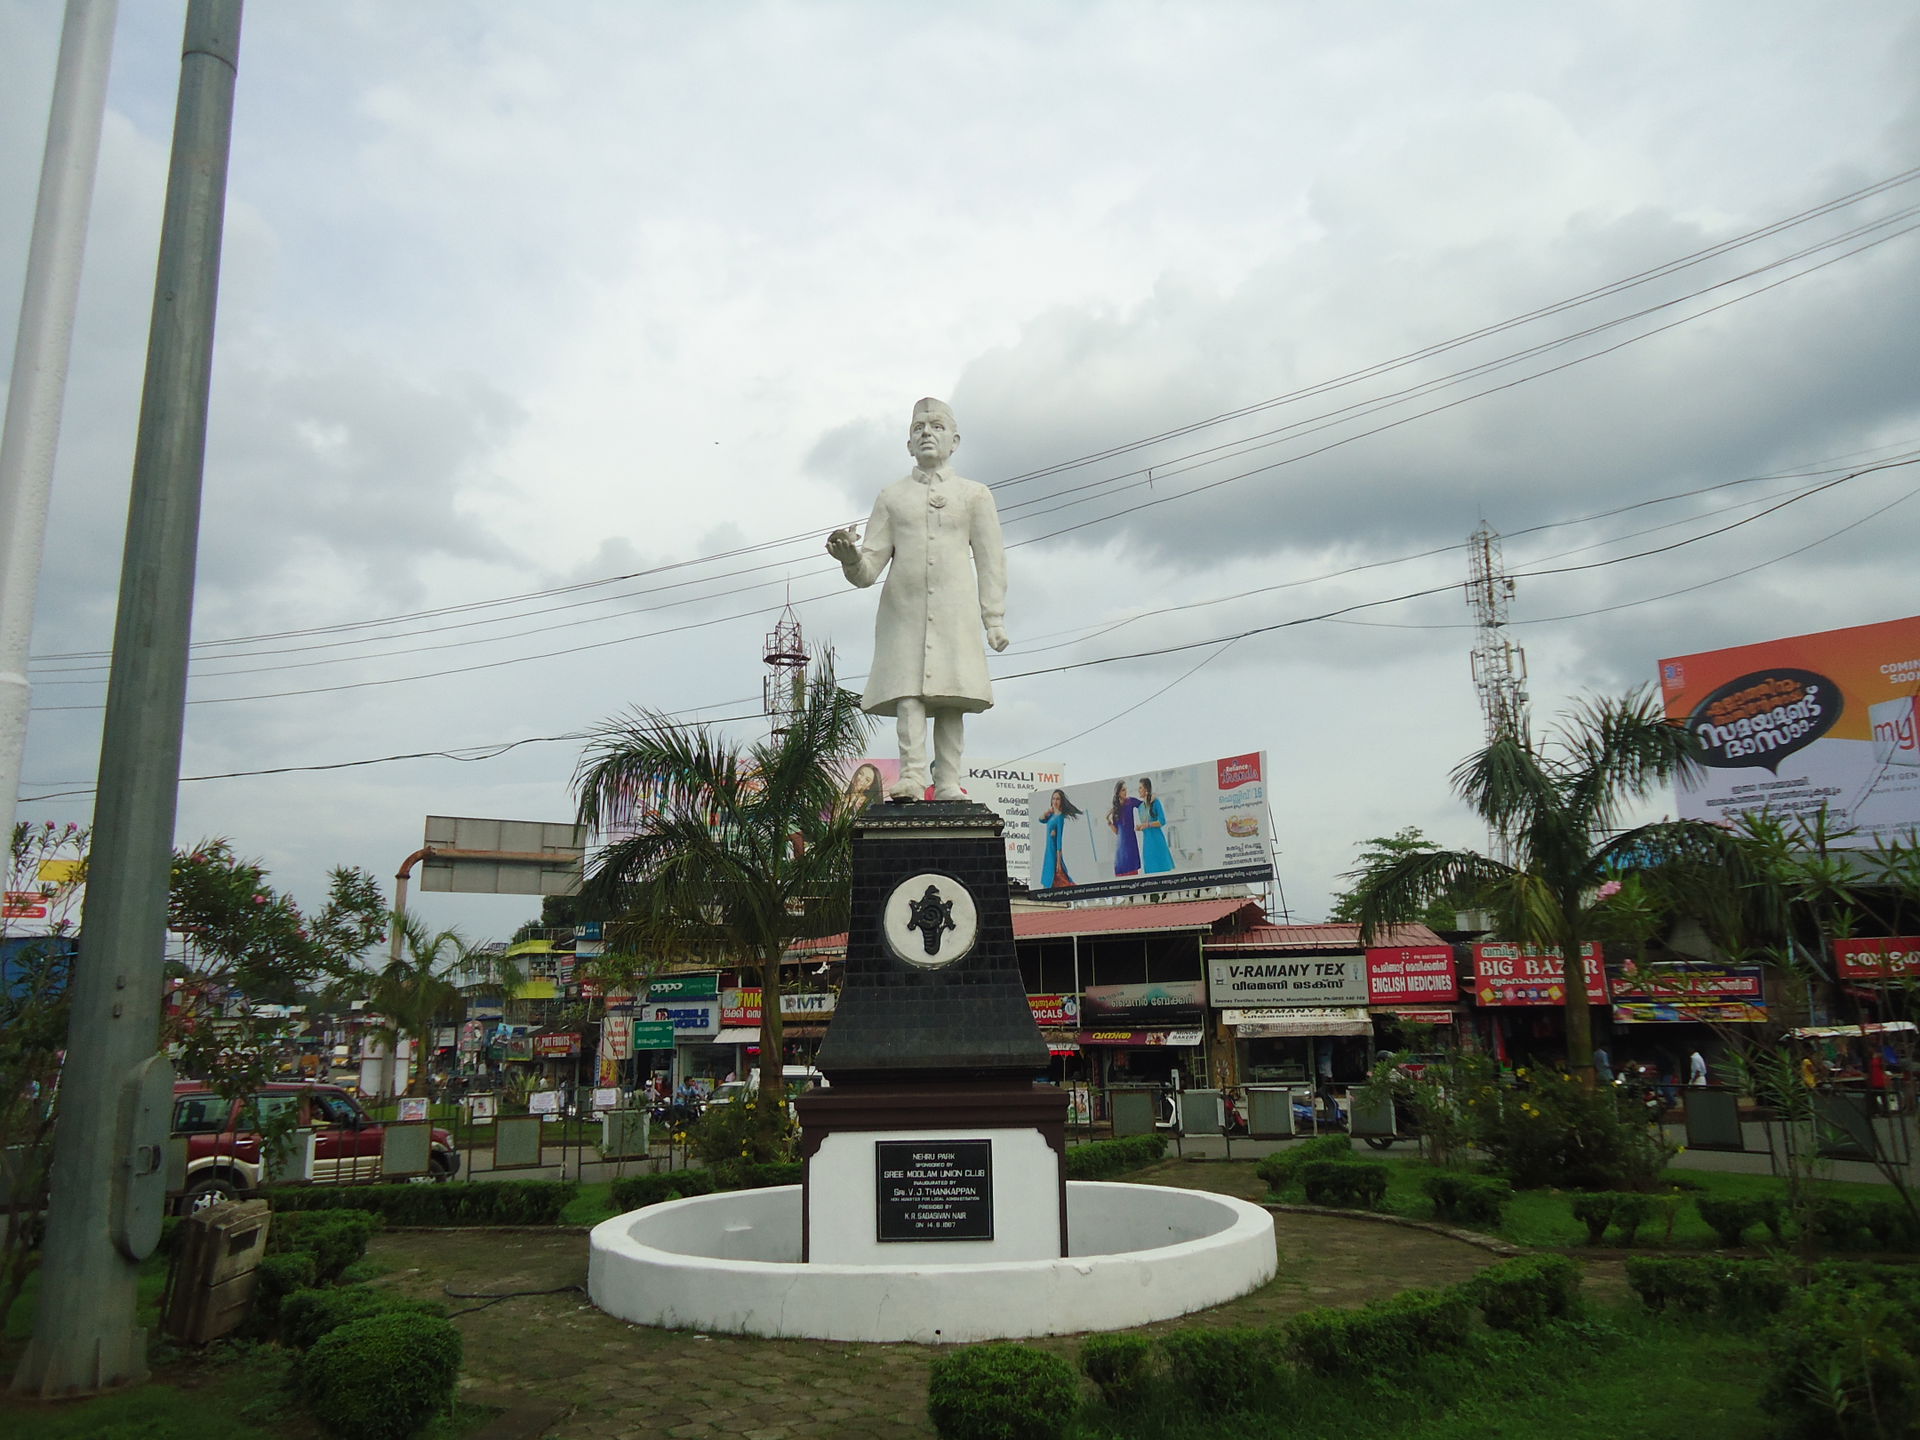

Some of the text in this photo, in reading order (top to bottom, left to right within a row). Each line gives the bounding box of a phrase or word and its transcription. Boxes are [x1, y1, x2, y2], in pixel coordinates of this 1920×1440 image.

[1880, 659, 1920, 675] COMIN
[1873, 716, 1915, 750] my
[968, 768, 1060, 783] KAIRALI TMT
[996, 782, 1016, 790] STEEL
[1229, 963, 1345, 978] V-RAMANY TEX
[1479, 959, 1599, 976] BIG BAZR
[1372, 974, 1452, 993] ENGLISH MEDICINES
[1033, 1009, 1063, 1019] DICALS
[884, 1169, 985, 1178] SREE MOOLAM UNION CLUB
